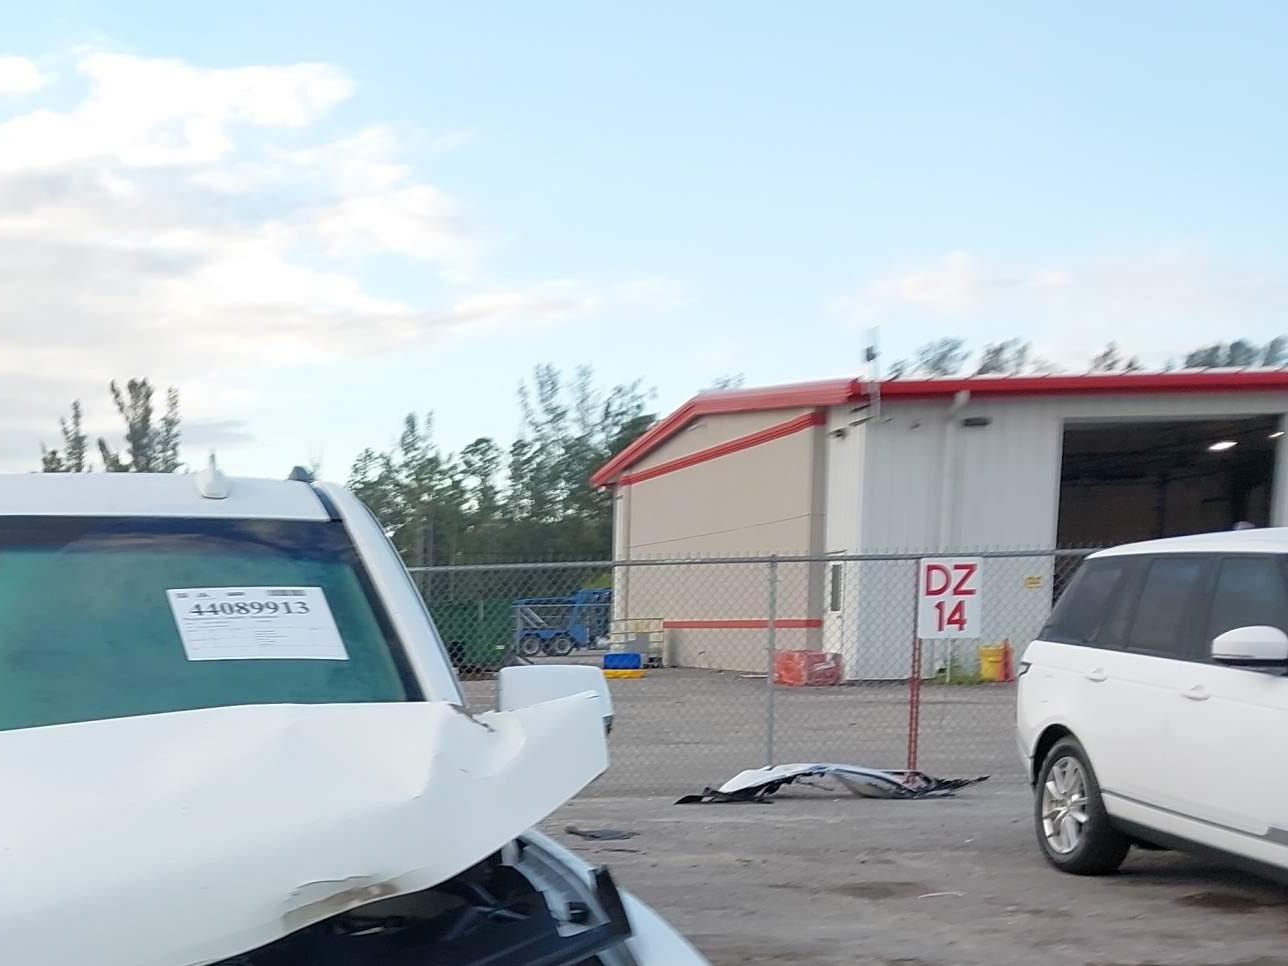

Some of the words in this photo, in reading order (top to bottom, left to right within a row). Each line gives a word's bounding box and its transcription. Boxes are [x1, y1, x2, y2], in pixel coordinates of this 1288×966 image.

[924, 563, 979, 597] DZ
[190, 601, 311, 616] 44089913
[933, 599, 968, 632] 14
